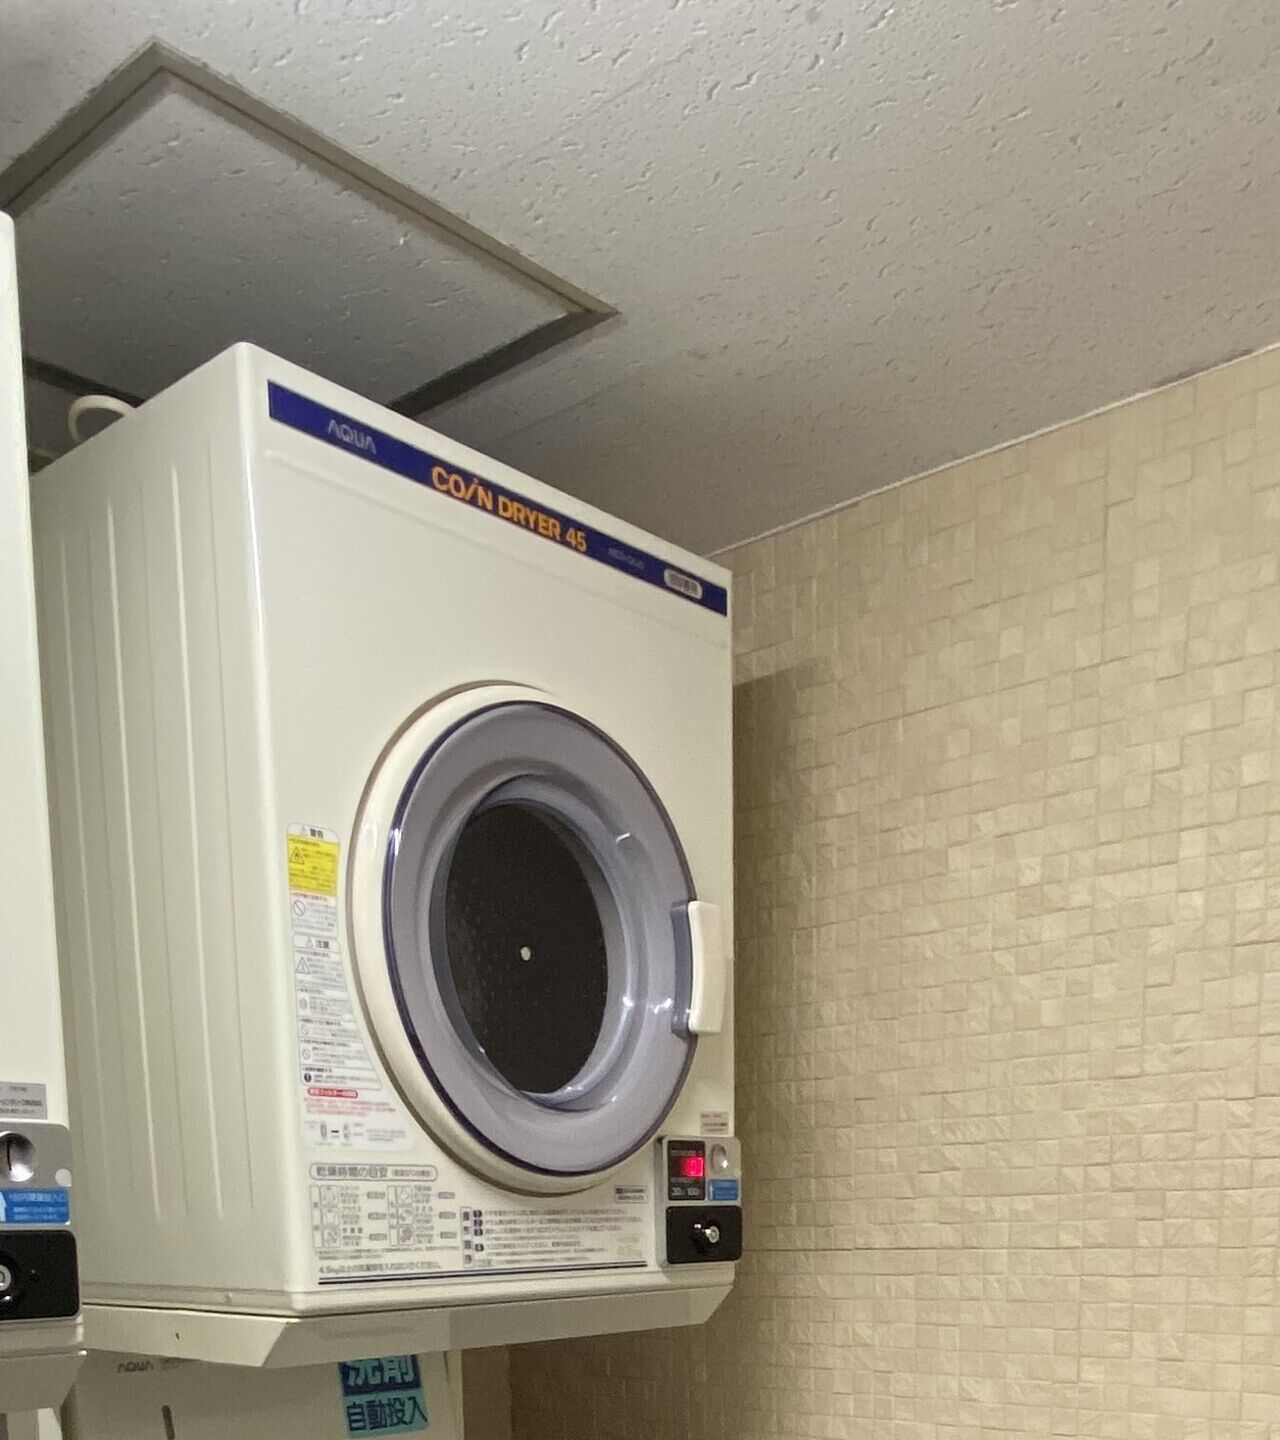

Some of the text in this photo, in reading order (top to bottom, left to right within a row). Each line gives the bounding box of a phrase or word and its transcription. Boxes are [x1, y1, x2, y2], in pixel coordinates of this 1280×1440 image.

[328, 418, 377, 456] AQUA
[497, 493, 563, 541] DRYER
[565, 525, 589, 553] 45
[346, 1395, 428, 1432] 自動投入
